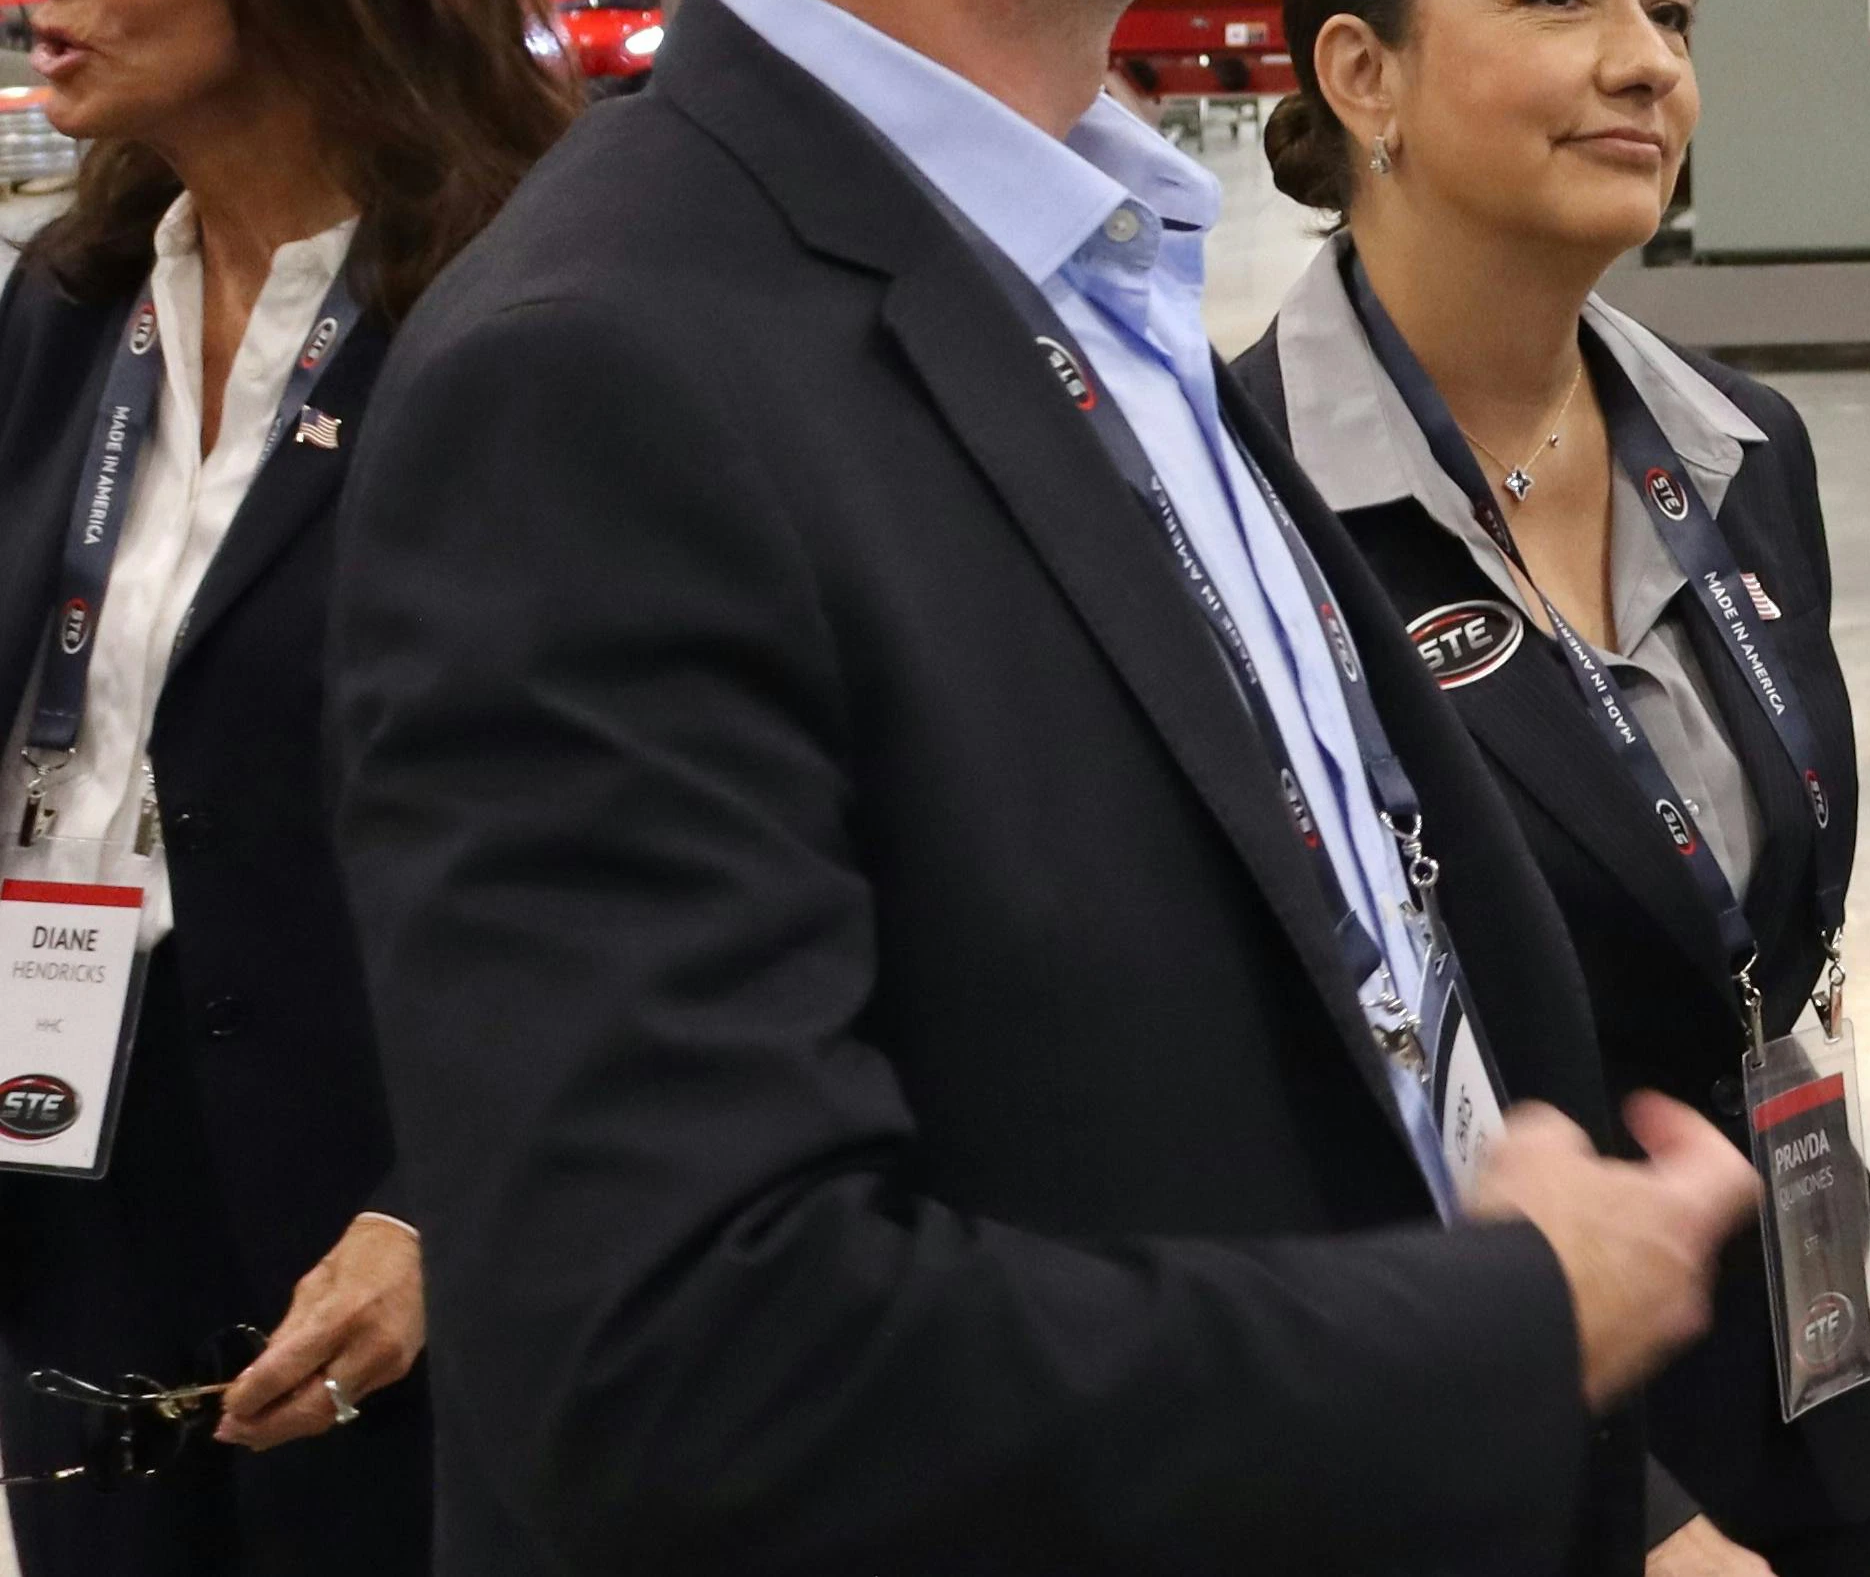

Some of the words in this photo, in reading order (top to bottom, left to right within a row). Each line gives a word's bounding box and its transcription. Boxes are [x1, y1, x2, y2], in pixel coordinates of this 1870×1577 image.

[105, 405, 131, 452] MADE
[101, 455, 120, 473] IN
[83, 474, 115, 545] AMERICA
[1652, 476, 1681, 510] STE
[1416, 616, 1494, 671] STE
[1703, 571, 1739, 620] MADE
[1730, 621, 1749, 642] IN
[1740, 643, 1787, 716] AMERICA
[1590, 672, 1608, 693] IN
[1601, 694, 1637, 744] MADE
[1661, 811, 1689, 845] STE
[32, 925, 99, 952] DIANE
[12, 960, 106, 984] HENDRICKS
[2, 1091, 67, 1122] STE
[1774, 1128, 1832, 1175] PRAVDA
